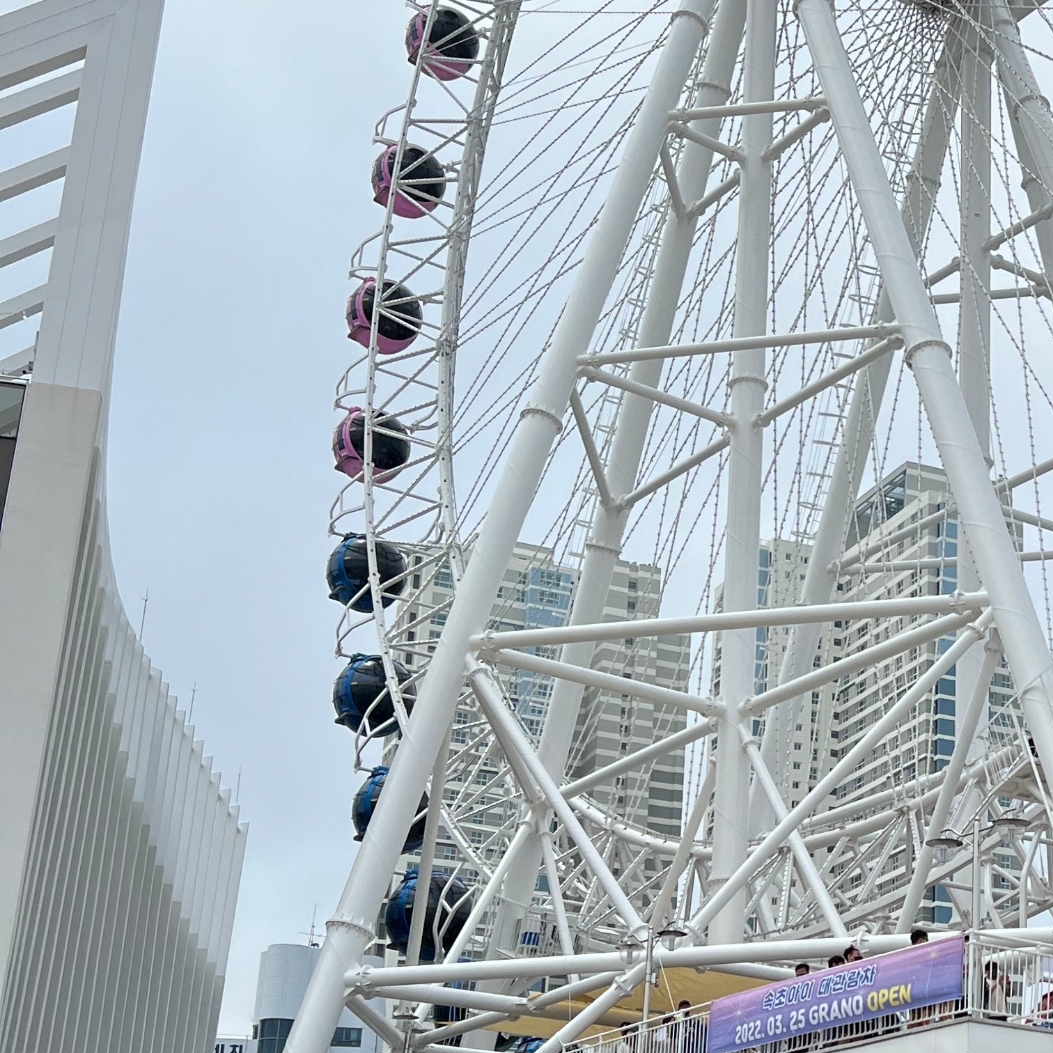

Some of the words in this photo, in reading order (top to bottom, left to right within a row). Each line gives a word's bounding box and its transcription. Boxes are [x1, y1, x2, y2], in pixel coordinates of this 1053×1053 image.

[735, 1020, 765, 1045] 2022.
[767, 1014, 787, 1036] 03.
[789, 1008, 806, 1031] 25
[809, 995, 863, 1025] GRAND
[867, 983, 912, 1012] OPEN
[763, 979, 815, 1010] 속초아이
[817, 964, 877, 996] 대관람차
